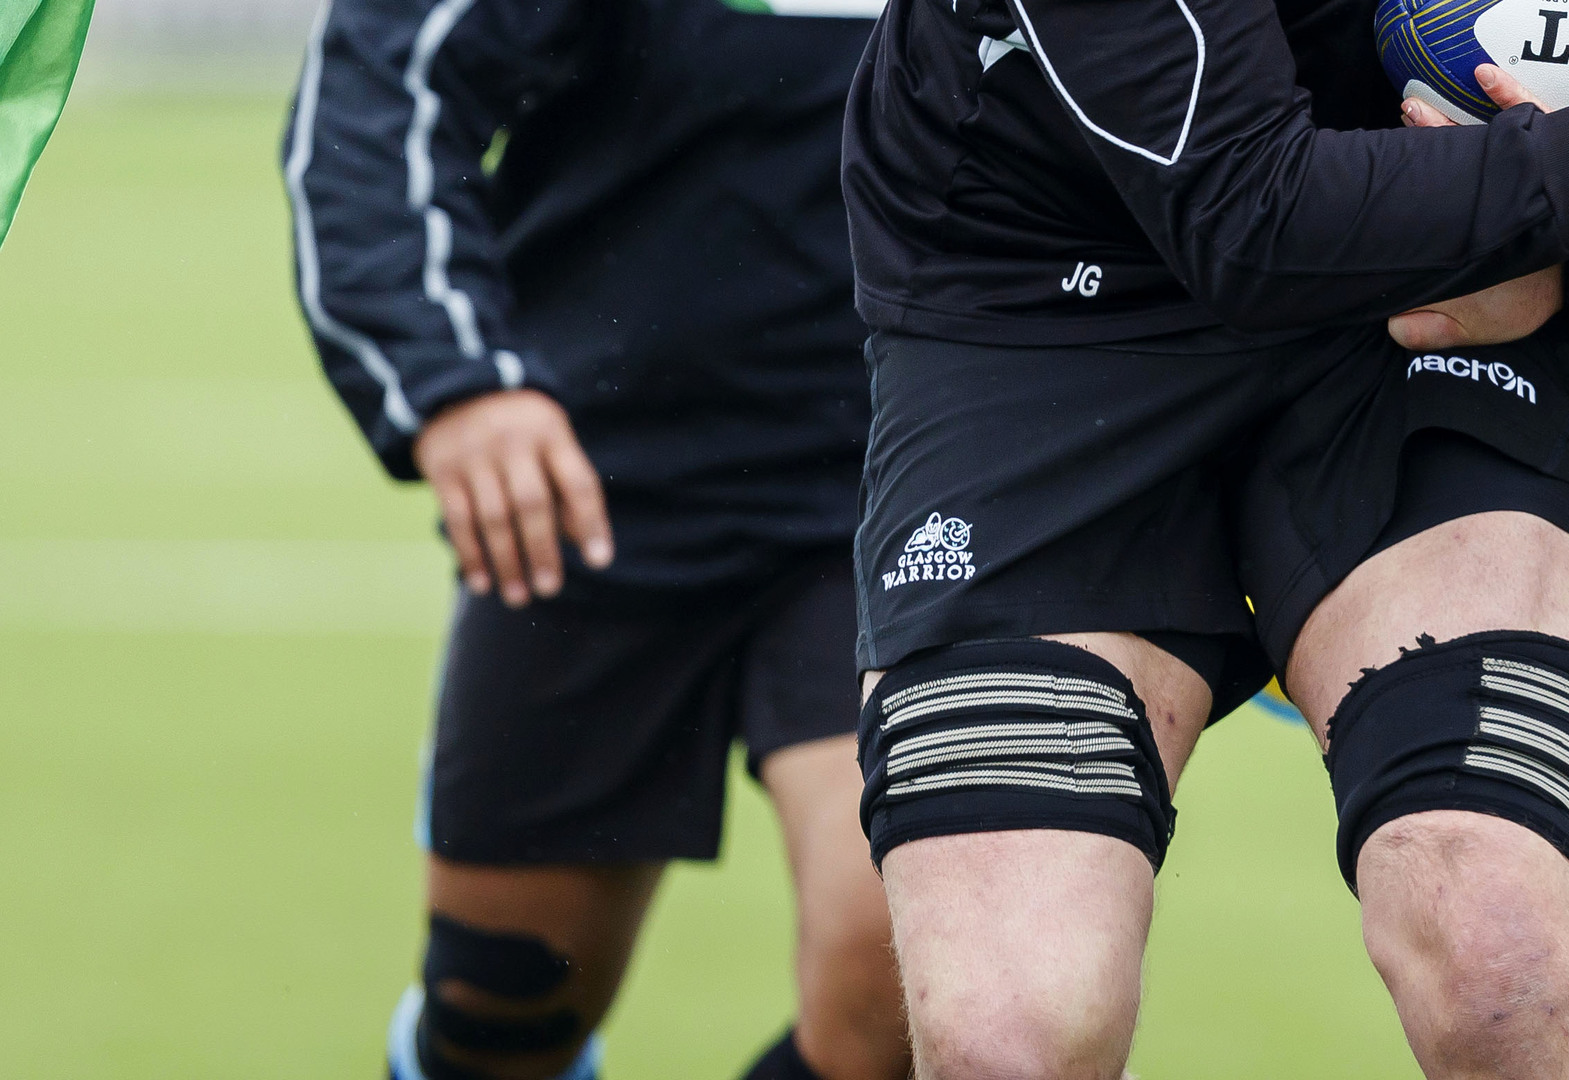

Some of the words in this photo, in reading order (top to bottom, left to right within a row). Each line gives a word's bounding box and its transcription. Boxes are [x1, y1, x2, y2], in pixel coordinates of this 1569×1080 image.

[1062, 261, 1102, 297] JG
[898, 550, 973, 568] GLASGOW
[882, 564, 976, 591] WARRIOR
